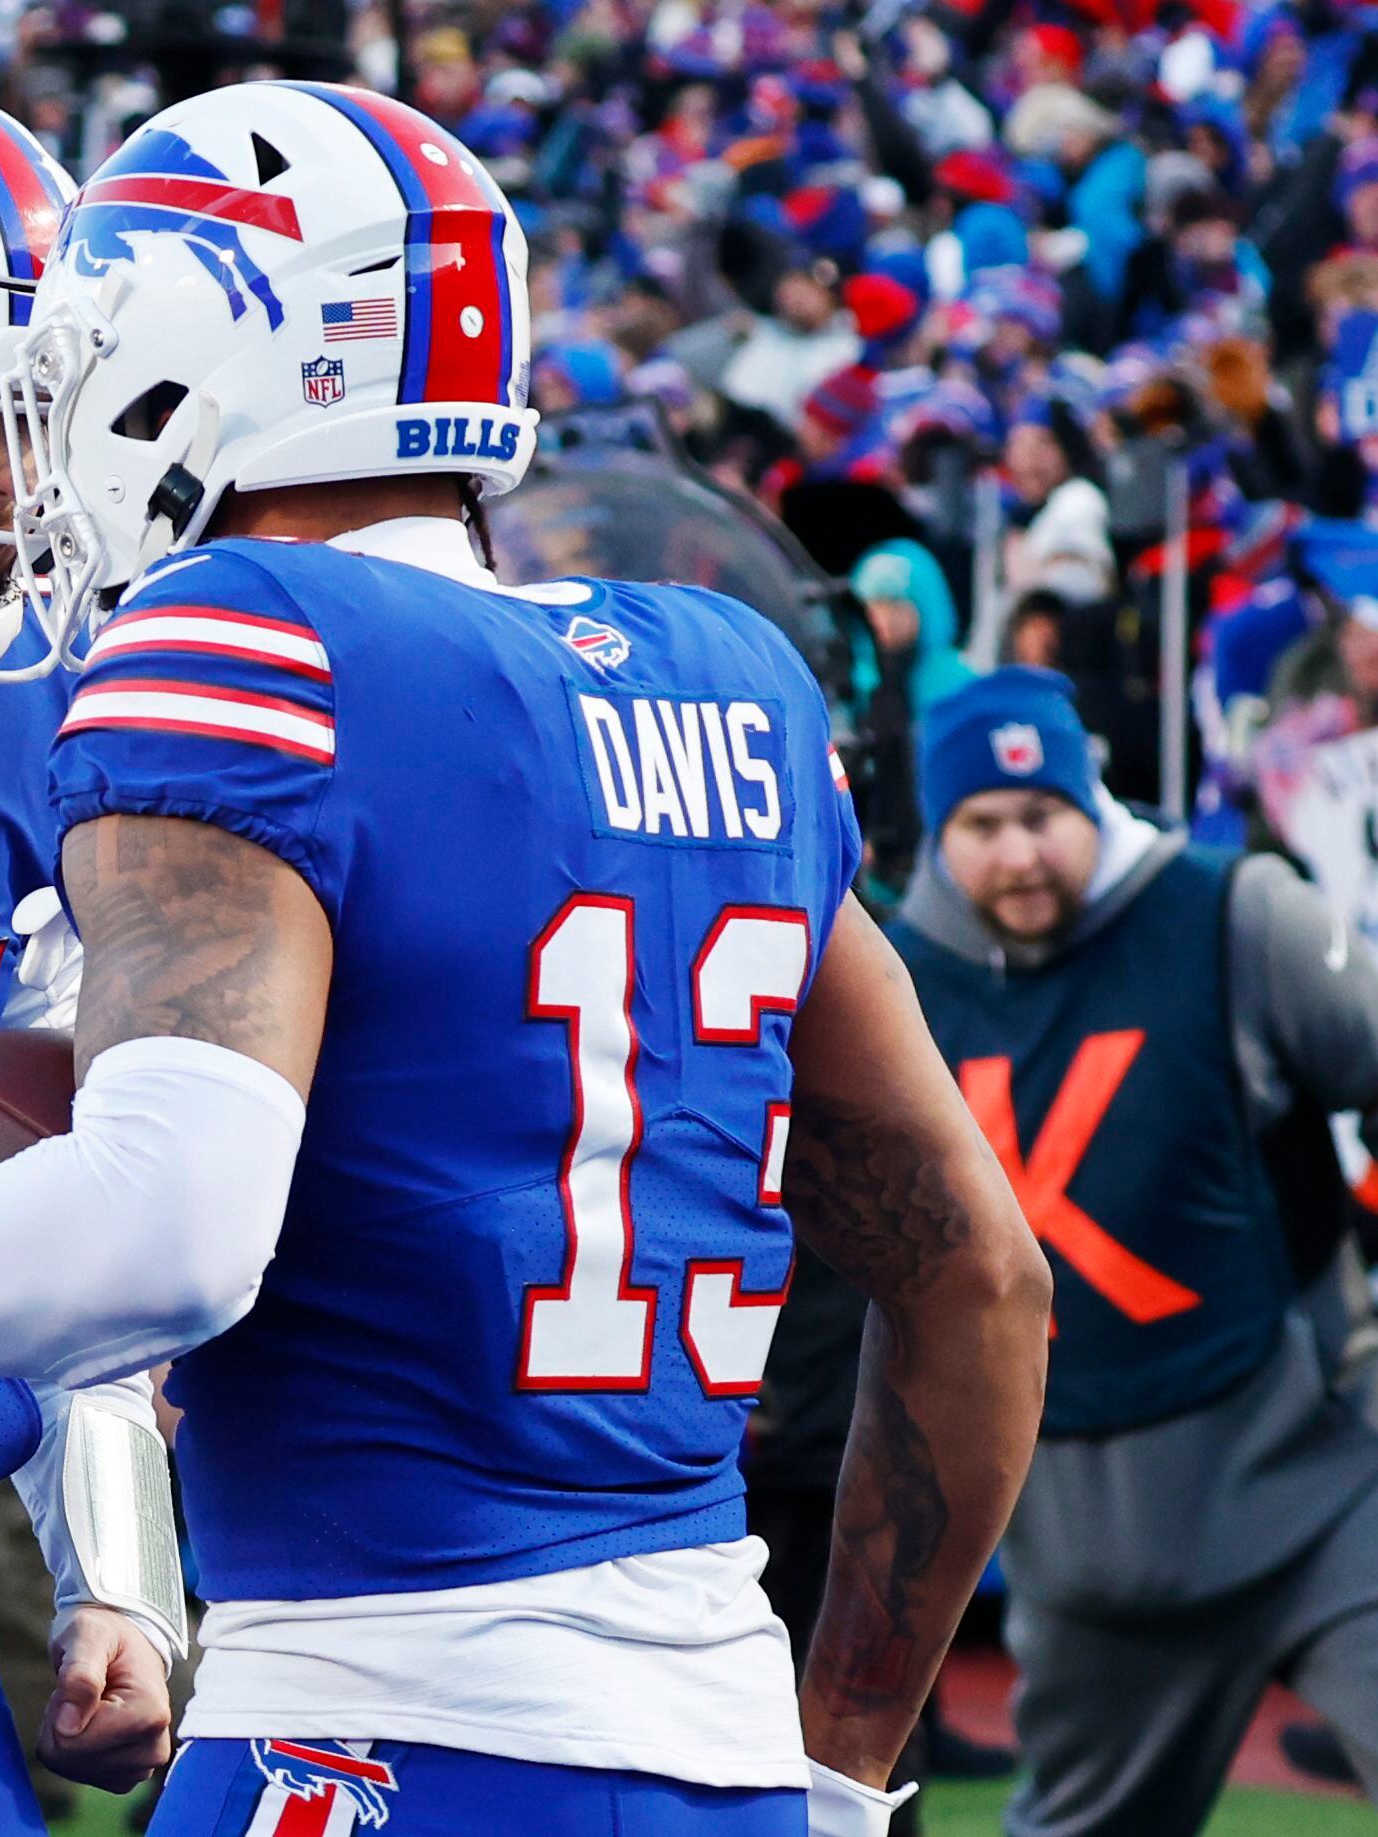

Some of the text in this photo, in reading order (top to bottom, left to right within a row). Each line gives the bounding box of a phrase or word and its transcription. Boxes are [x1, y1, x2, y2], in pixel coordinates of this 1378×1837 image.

[307, 377, 342, 402] NFL
[395, 417, 521, 462] BILLS
[578, 693, 782, 840] DAVIS
[515, 889, 812, 1400] 13
[959, 1028, 1204, 1341] K
